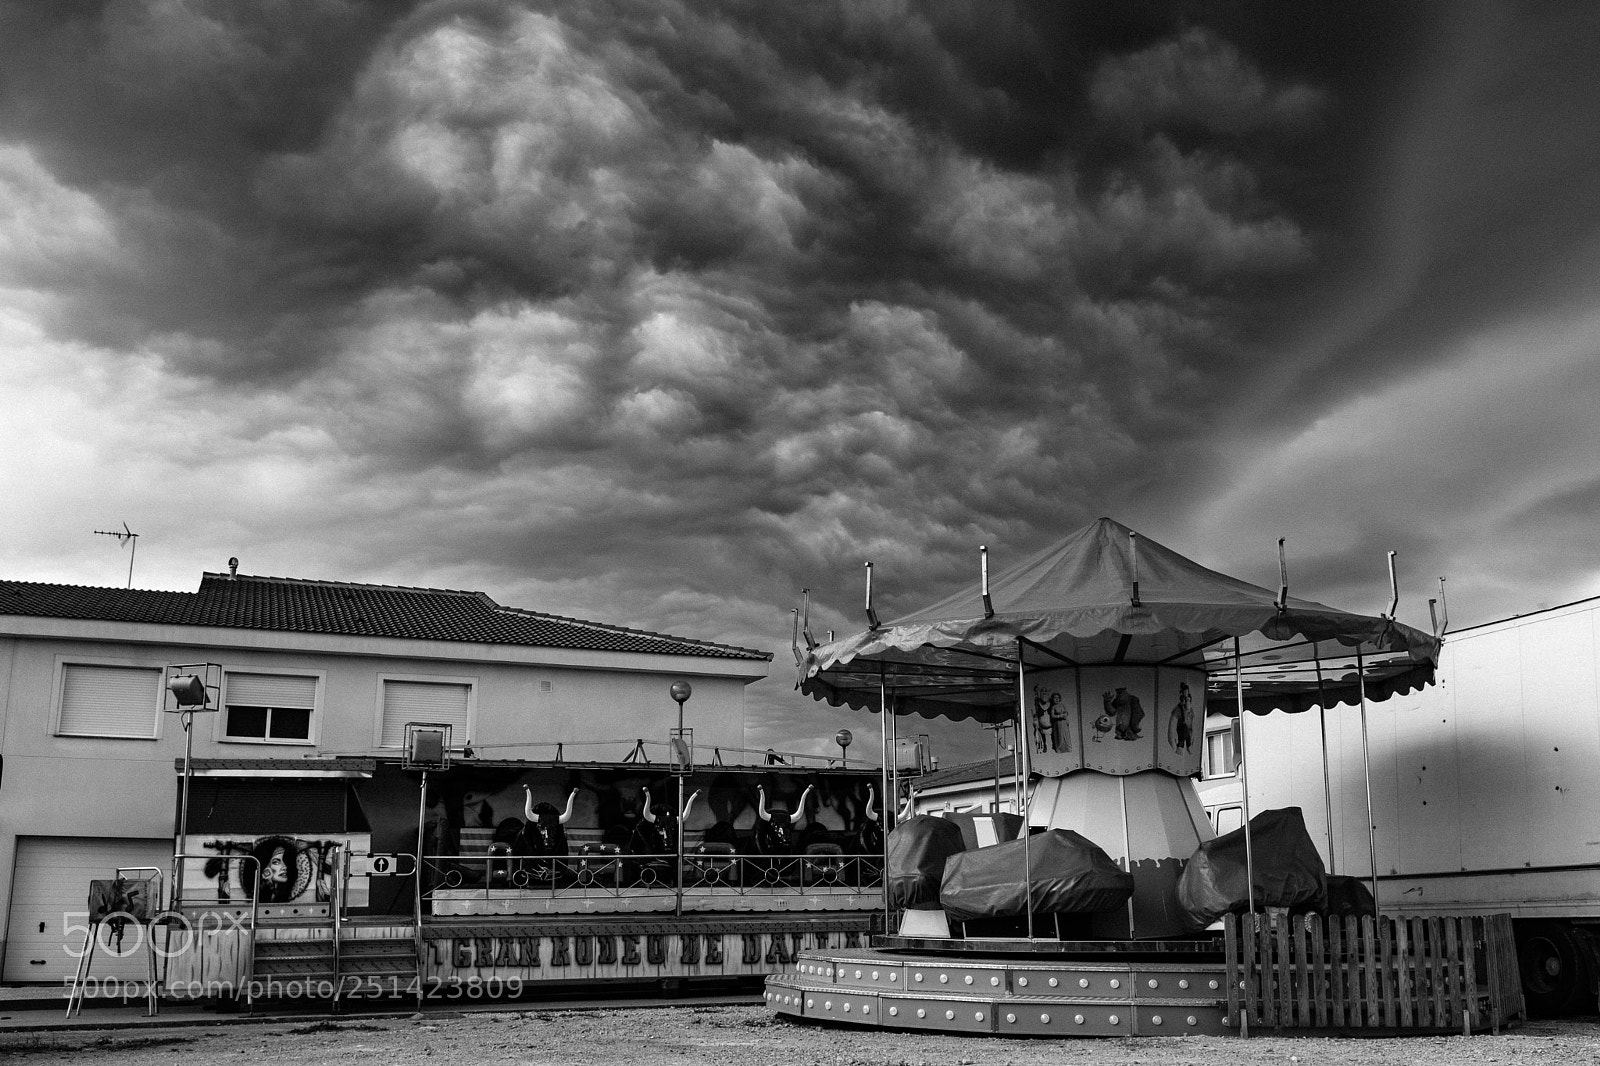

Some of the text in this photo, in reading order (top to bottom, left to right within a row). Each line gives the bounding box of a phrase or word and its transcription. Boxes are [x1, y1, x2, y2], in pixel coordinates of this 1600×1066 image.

[452, 937, 541, 968] GRAN
[550, 935, 666, 966] RODEO
[680, 934, 723, 965] DE
